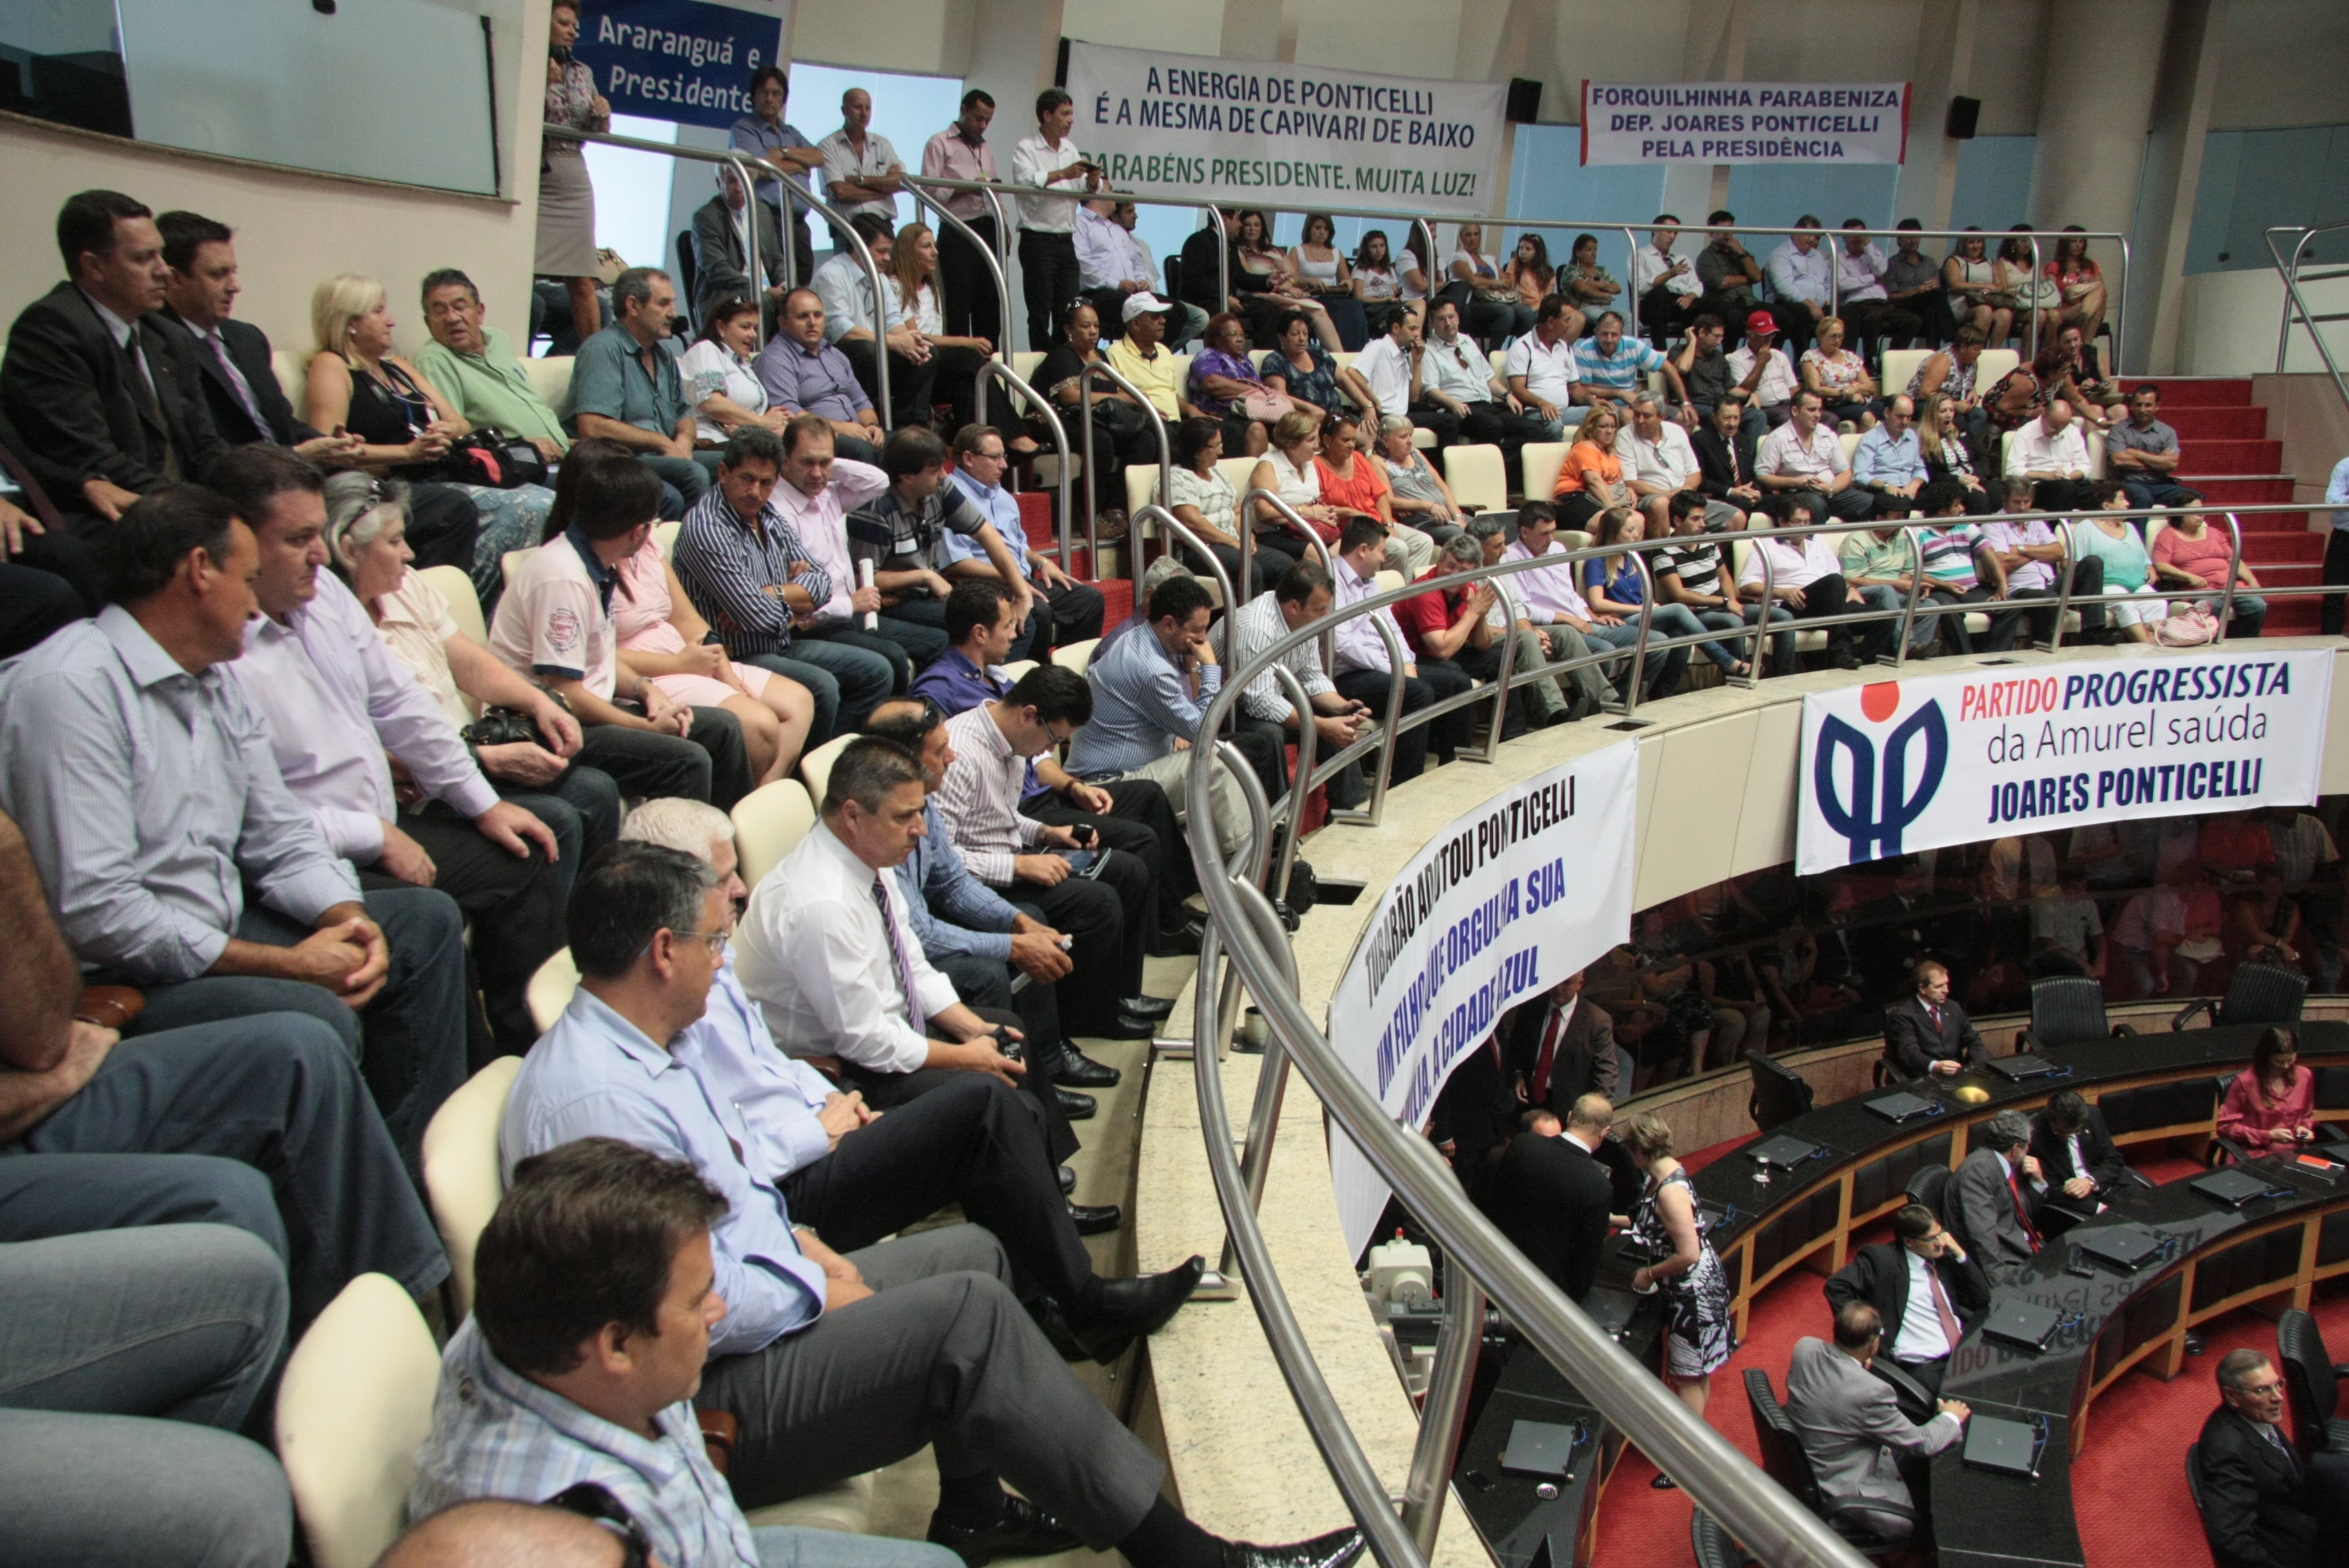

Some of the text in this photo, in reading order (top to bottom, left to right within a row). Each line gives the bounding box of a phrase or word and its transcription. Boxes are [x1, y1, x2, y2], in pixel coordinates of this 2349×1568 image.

[598, 14, 735, 68] Araranguá
[747, 48, 761, 70] e
[609, 65, 753, 114] Presidente
[1146, 67, 1433, 115] A ENERGIA DE PONTICELLI
[1592, 88, 1899, 108] FORQUILHINHA PARABENIZA
[1095, 91, 1475, 148] É A MESMA DE CAPIVARI DE BAIXO
[1611, 114, 1879, 133] DEP. JOARES PONTICELLI
[1642, 137, 1844, 158] PELA PRESIDÊNCIA
[1211, 158, 1351, 190] PRESIDENTE.
[1356, 167, 1425, 194] MUITA
[1431, 172, 1476, 197] LUZ!
[1960, 661, 2290, 721] PARTIDO PROGRESSISTA
[1988, 702, 2267, 764] da Amurel saúda
[1988, 756, 2263, 825] JOARES PONTICELLI
[1366, 883, 1416, 1009] TUBARÃO
[1478, 775, 1576, 869] PONTICELLI
[1377, 857, 1566, 1102] UM FILHO QUE ORGULHA SUA
[1433, 1033, 1440, 1087] A
[1442, 974, 1496, 1069] CIDADE
[1496, 945, 1539, 1012] AZUL
